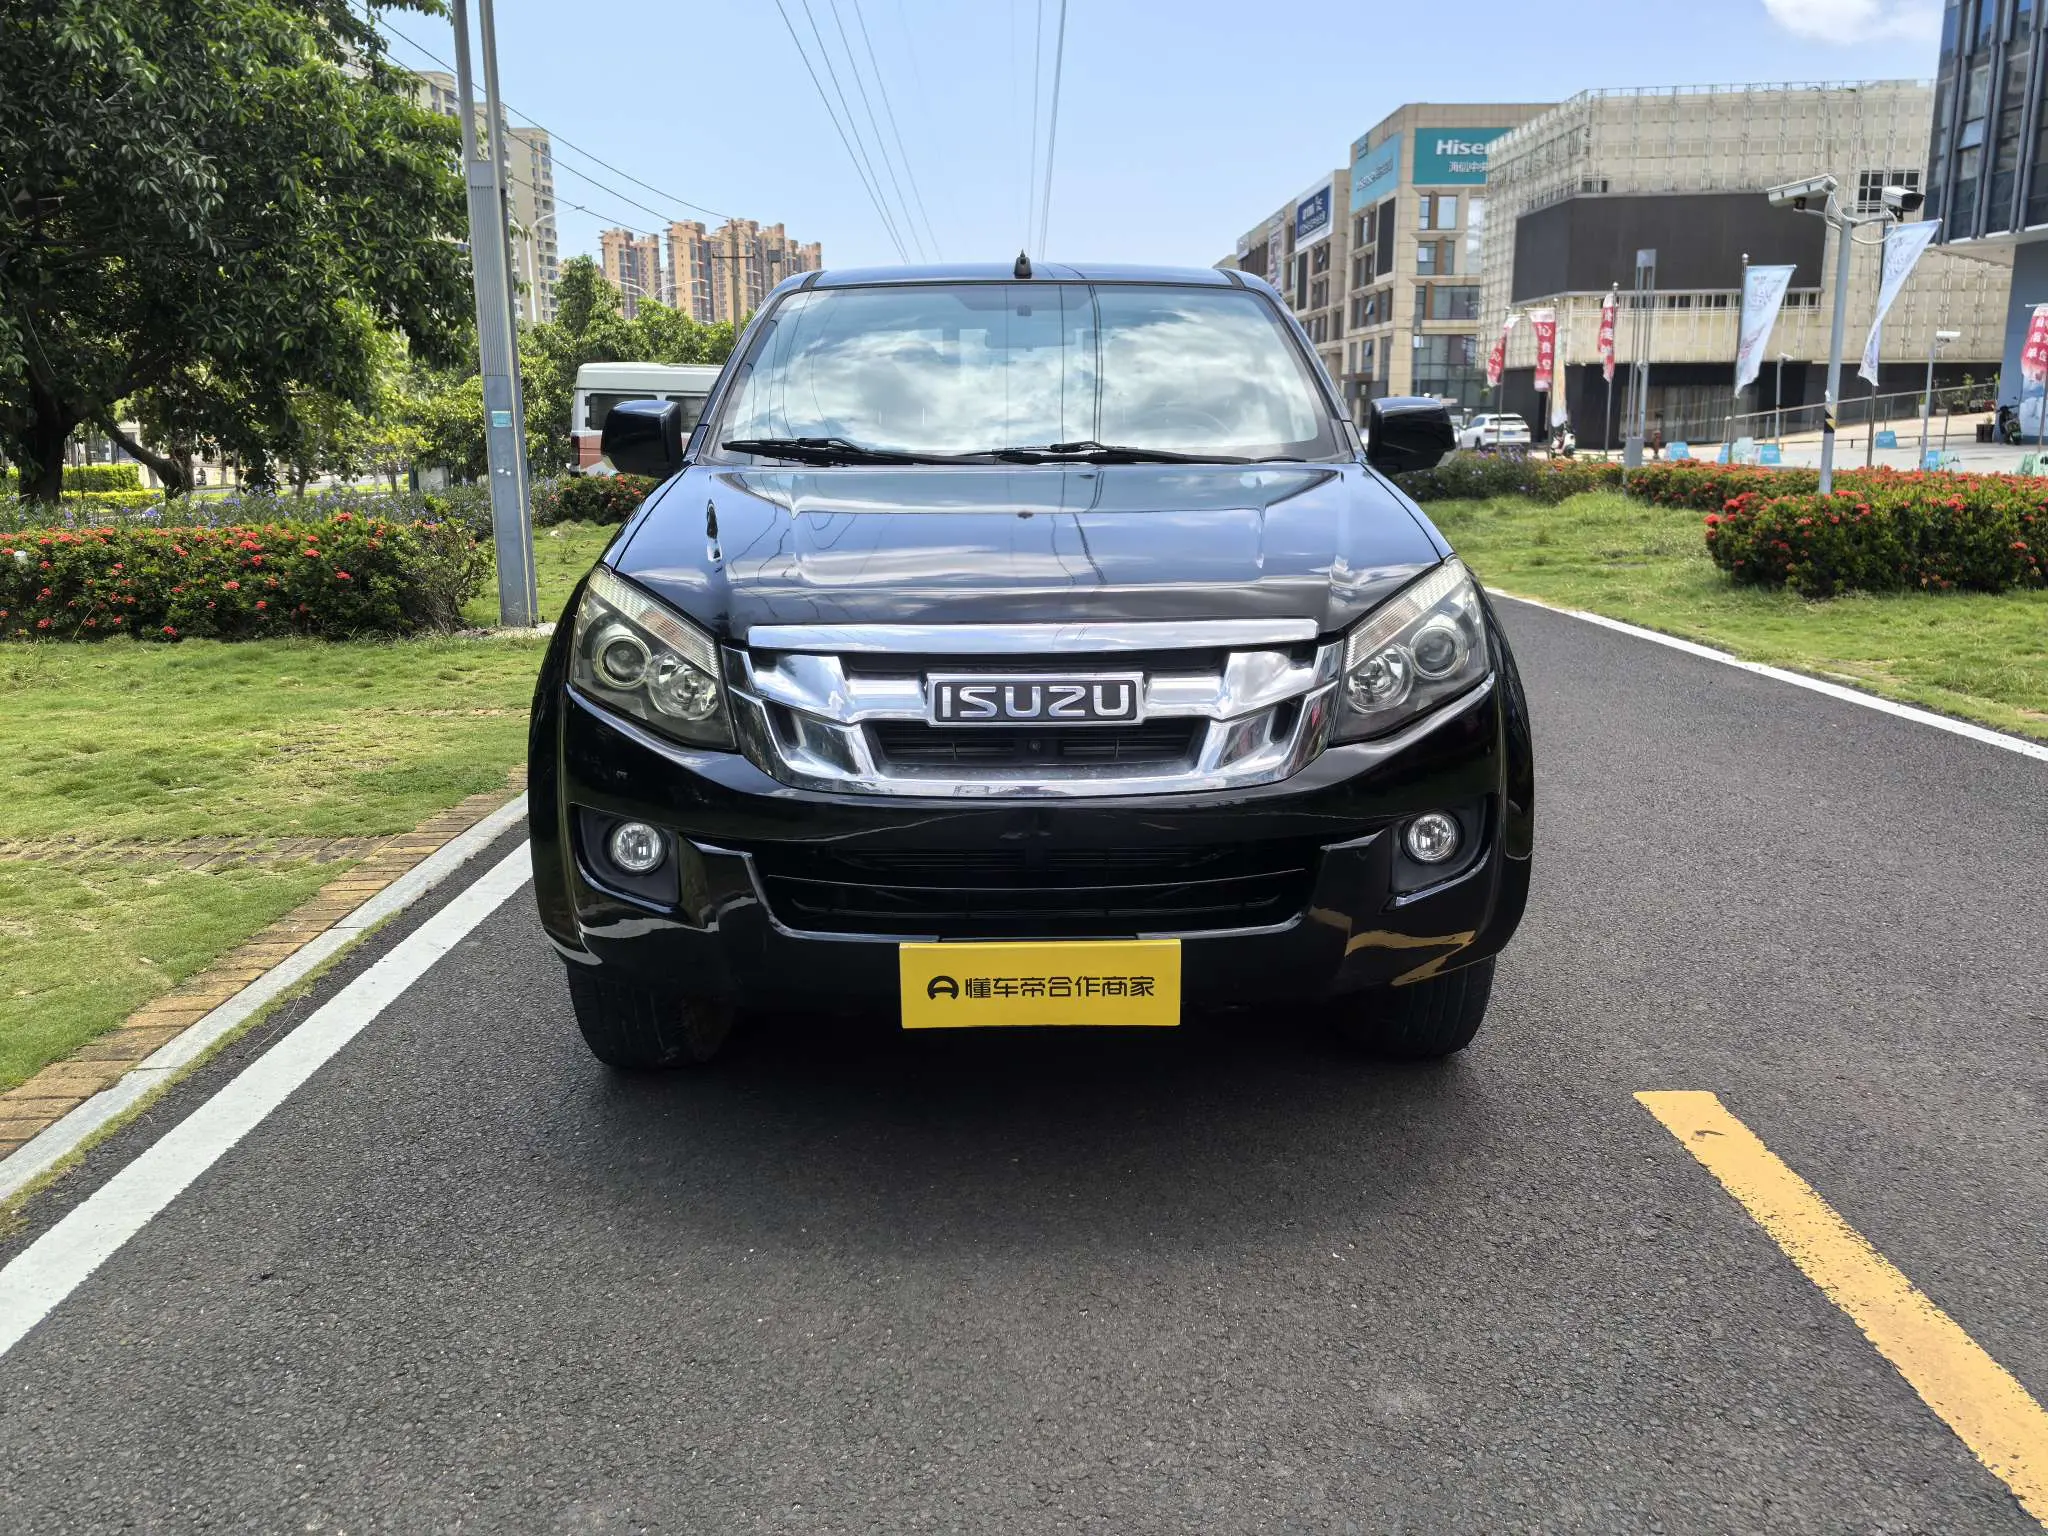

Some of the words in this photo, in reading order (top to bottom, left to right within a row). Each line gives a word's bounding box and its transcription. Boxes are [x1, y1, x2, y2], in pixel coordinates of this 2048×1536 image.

[942, 684, 1129, 718] ISUZU
[965, 976, 1155, 999] 懂车帝合作商家
